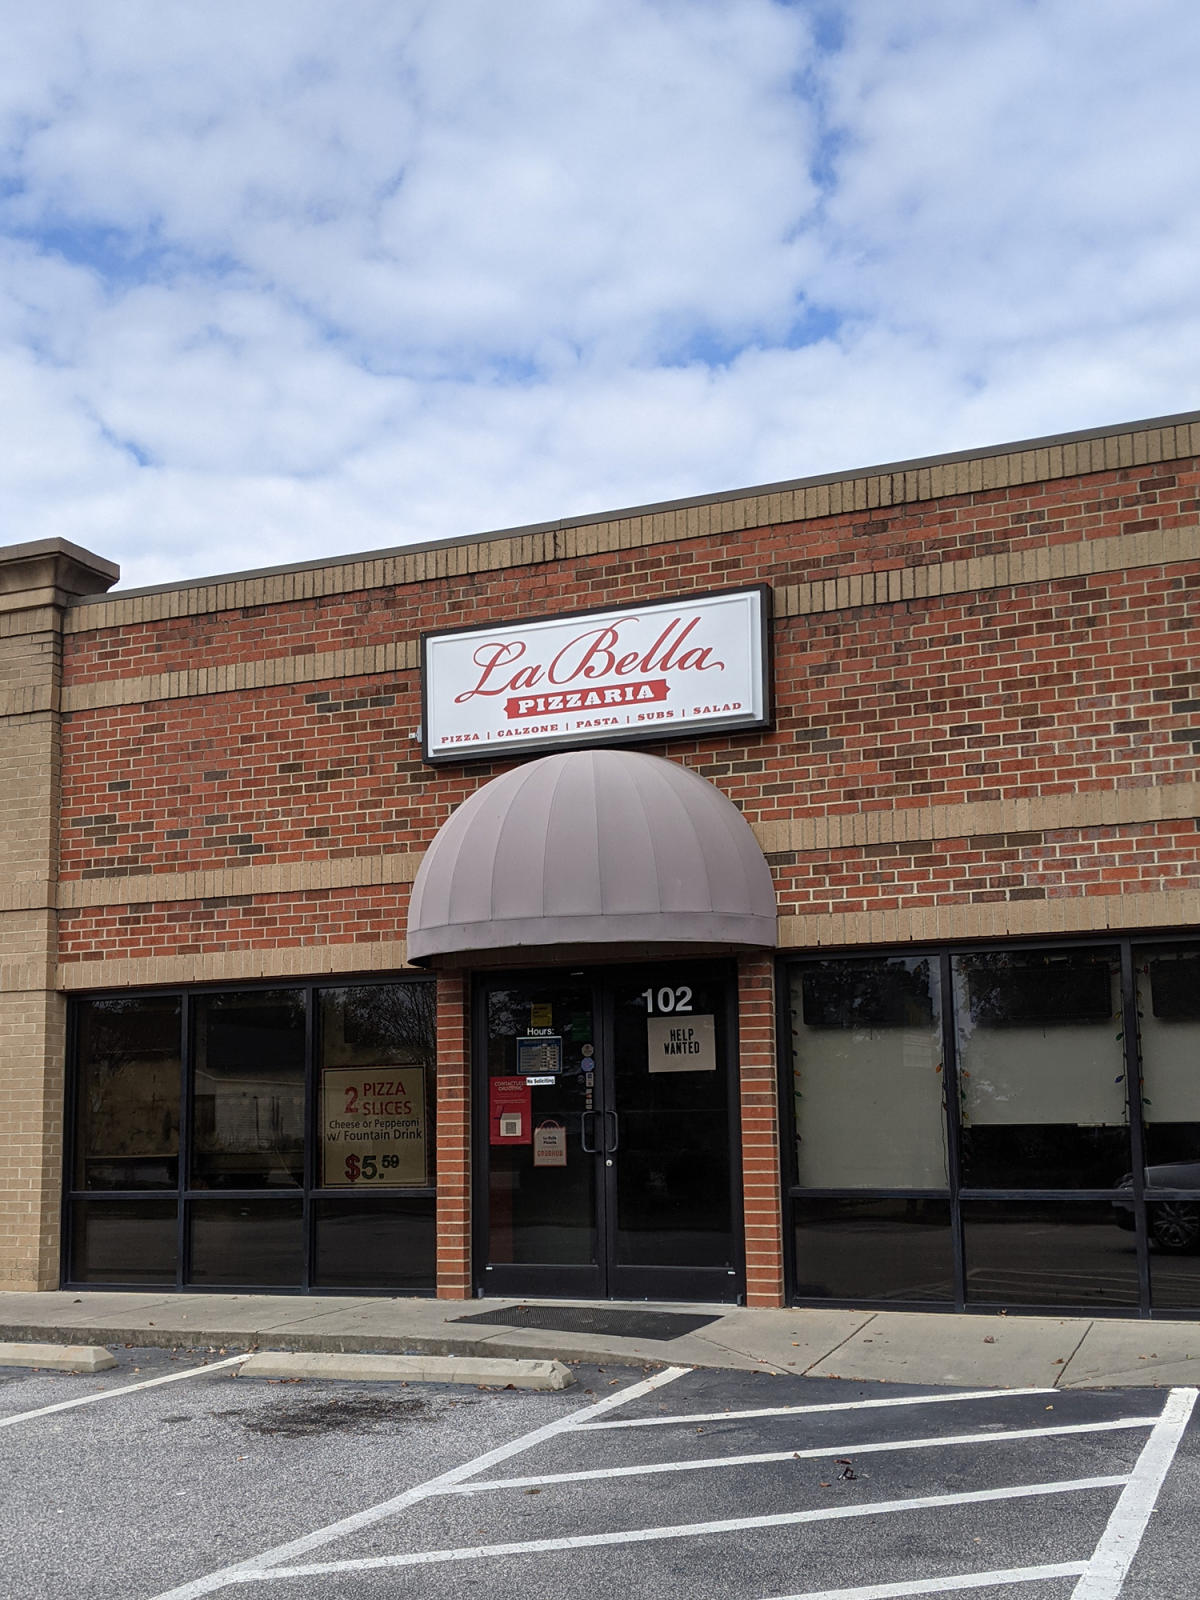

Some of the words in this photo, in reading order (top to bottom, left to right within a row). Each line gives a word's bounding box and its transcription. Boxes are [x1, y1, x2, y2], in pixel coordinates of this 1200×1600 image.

[455, 641, 546, 704] La
[547, 616, 725, 685] Bella
[518, 685, 655, 714] PIZZARIA
[441, 733, 480, 744] PIZZA
[497, 723, 559, 737] CALZONE
[576, 717, 619, 728] PASTA
[637, 710, 674, 721] SUBS
[693, 702, 742, 715] SALAD
[641, 986, 693, 1013] 102
[527, 1027, 555, 1036] Hours:
[670, 1028, 694, 1042] HELP
[664, 1041, 700, 1055] WANTED
[363, 1082, 406, 1097] PIZZA
[344, 1086, 359, 1114] 2
[363, 1101, 412, 1116] SLICES
[329, 1120, 360, 1129] Cheese
[362, 1120, 372, 1128] or
[374, 1117, 420, 1129] Pepperoni
[327, 1131, 341, 1141] w/
[344, 1129, 390, 1141] Fountain
[393, 1128, 423, 1140] Drink
